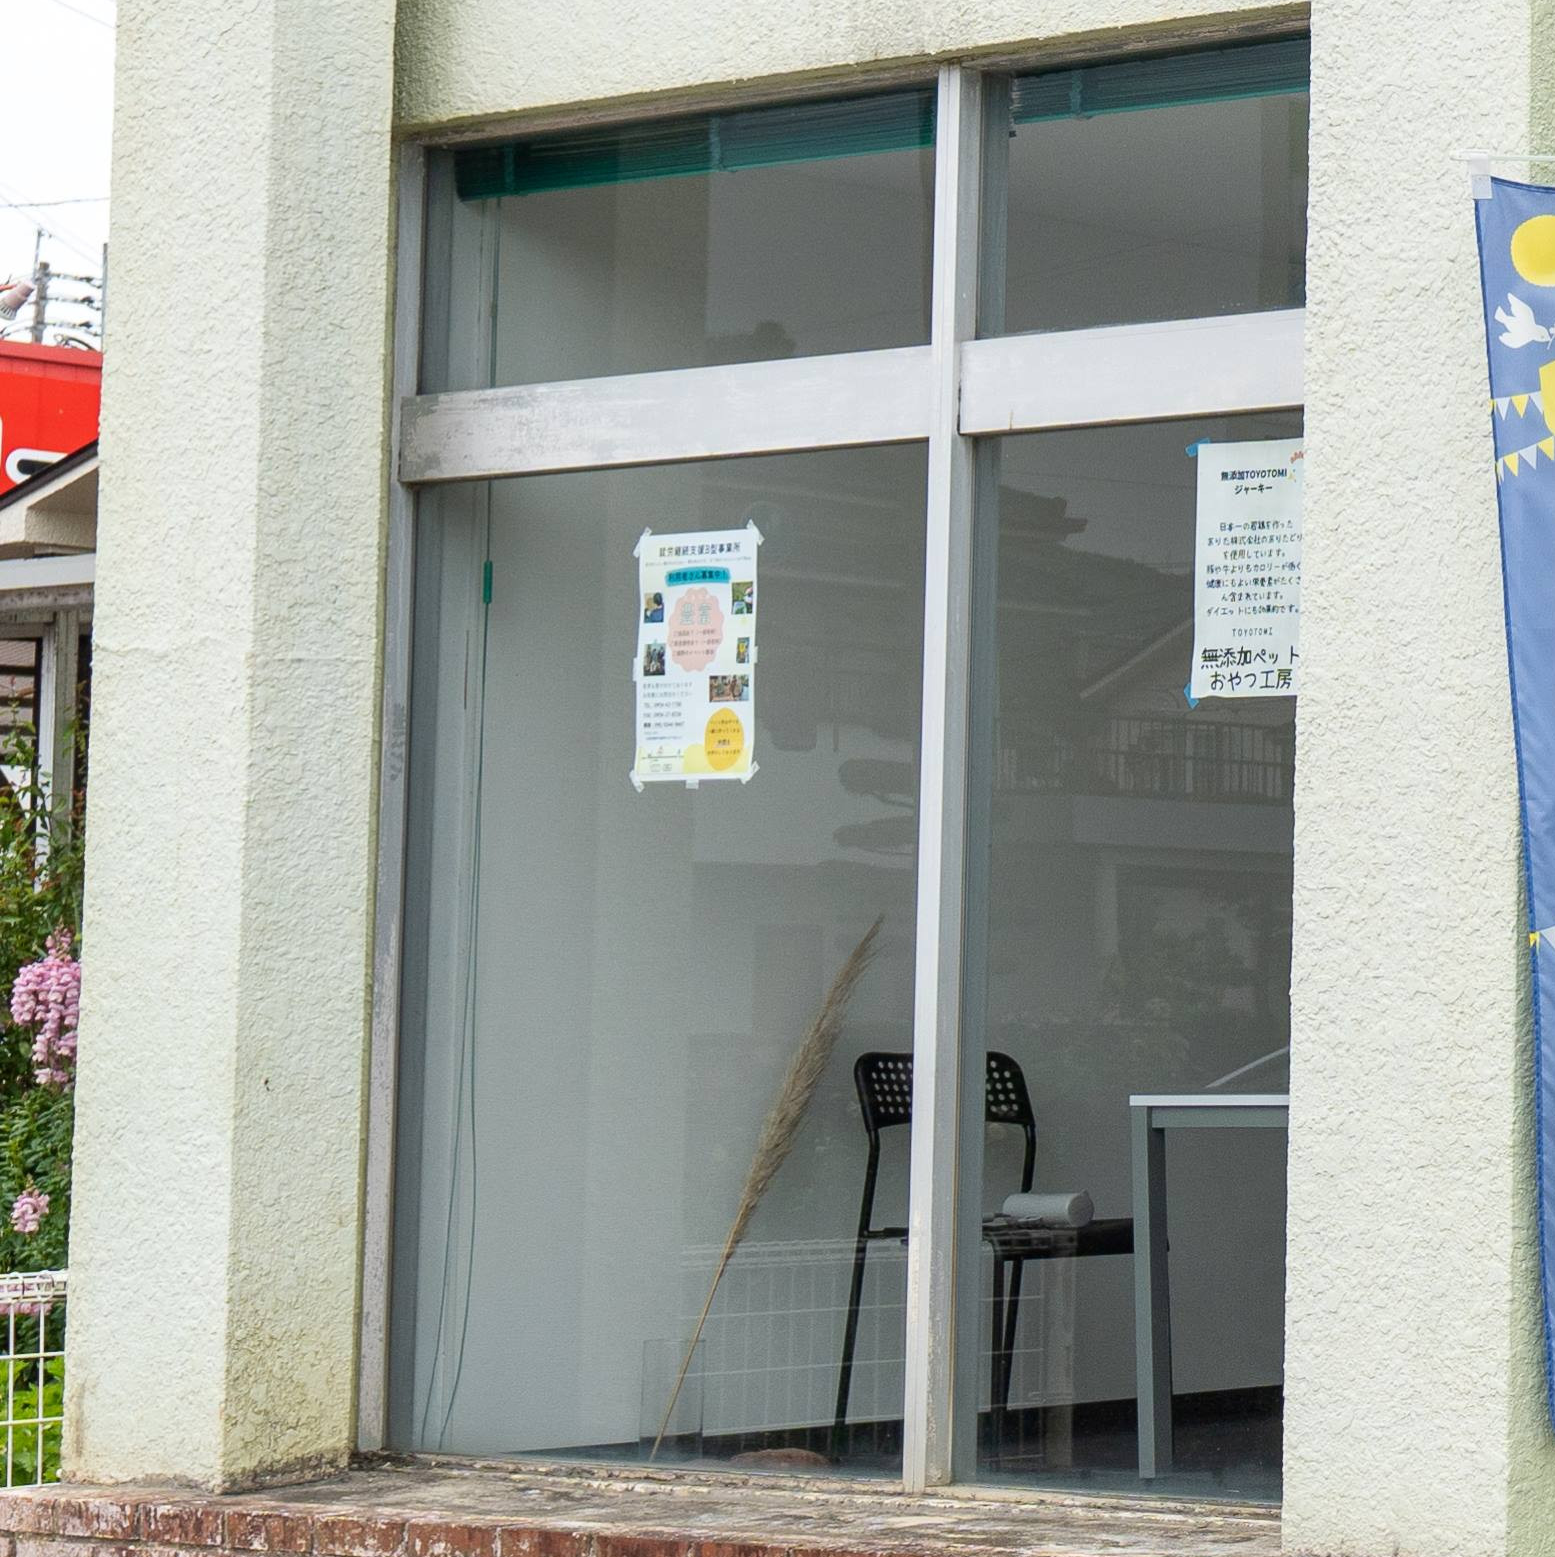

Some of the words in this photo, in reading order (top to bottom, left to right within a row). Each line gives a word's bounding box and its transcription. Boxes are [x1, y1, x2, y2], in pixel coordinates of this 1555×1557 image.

[1220, 468, 1288, 482] 無添加TOYOTOMI
[1234, 484, 1273, 495] ジャーキー
[1223, 547, 1286, 560] を使用しています。
[1231, 628, 1273, 637] TOYOTOMI
[1200, 645, 1300, 669] 無添加ペット
[1210, 668, 1293, 692] おやつ工房
